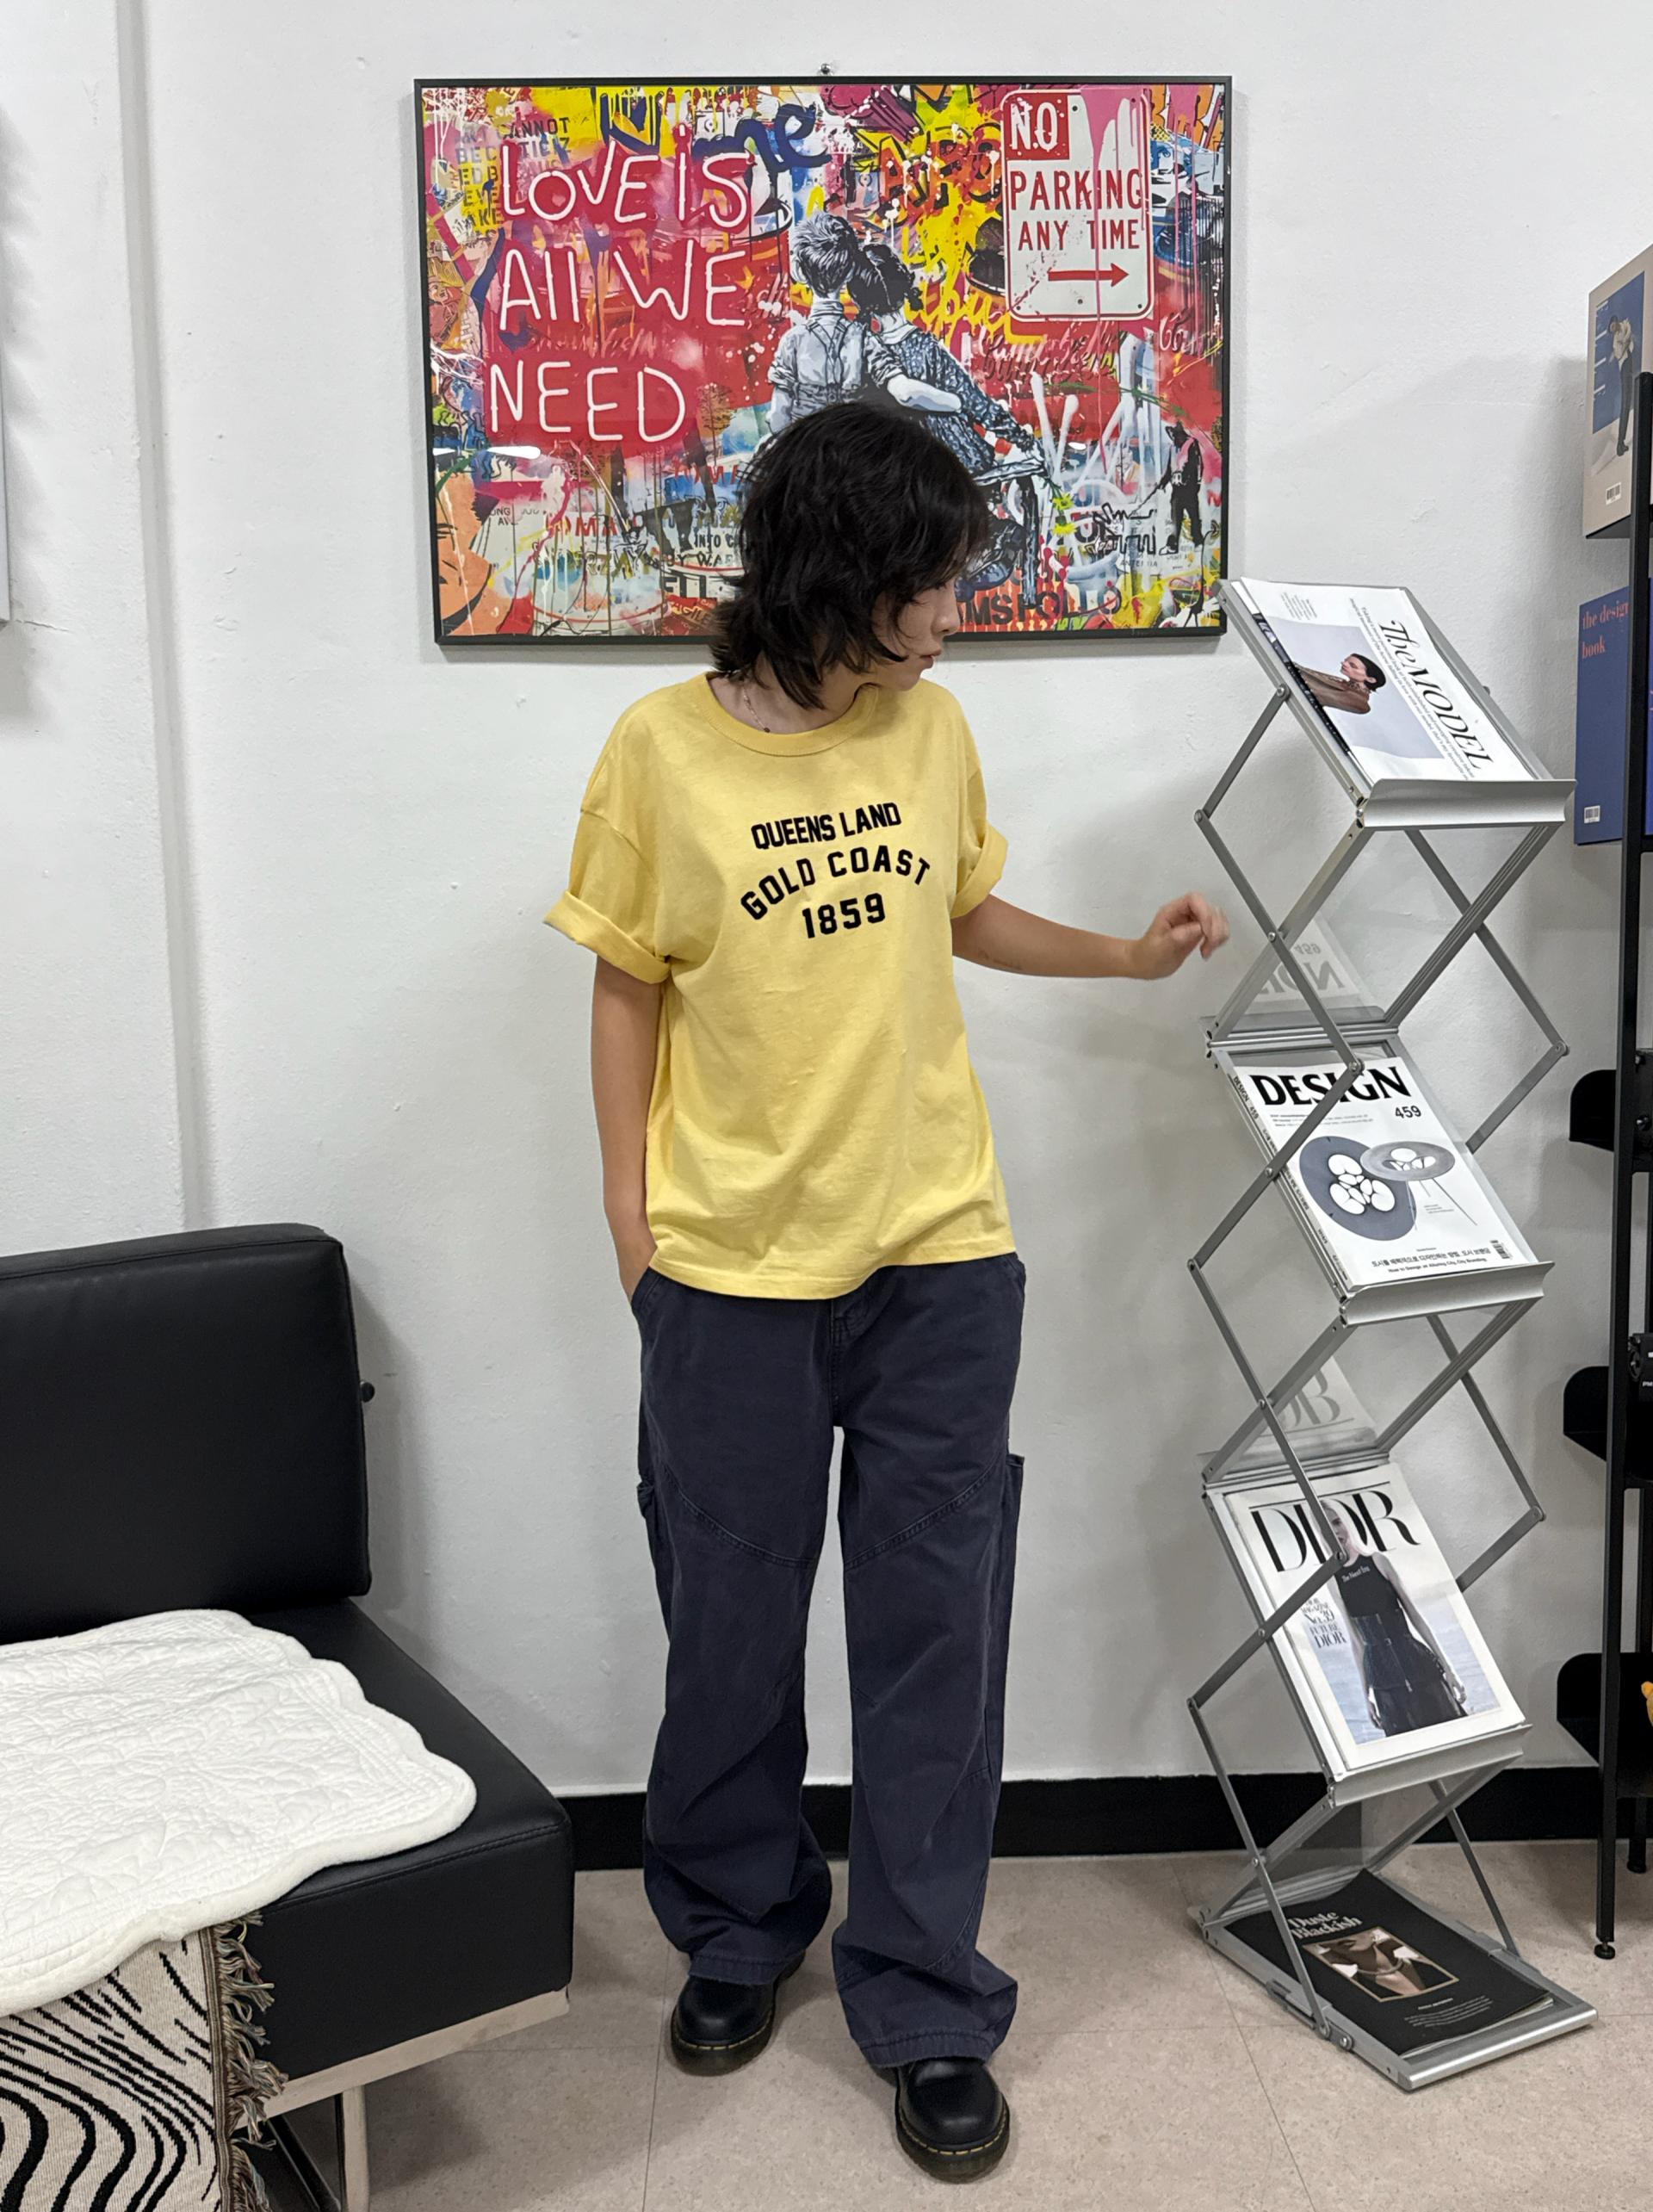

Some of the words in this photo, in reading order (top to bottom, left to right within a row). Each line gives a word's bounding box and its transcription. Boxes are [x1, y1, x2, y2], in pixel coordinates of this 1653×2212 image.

[1010, 102, 1058, 152] NO
[502, 140, 659, 223] LOVE
[1010, 169, 1142, 211] PARKING
[1018, 220, 1069, 251] ANY
[1089, 219, 1140, 250] TIME
[613, 239, 746, 327] WE
[490, 360, 685, 443] NEED
[1582, 610, 1597, 629] the
[1582, 635, 1606, 659] book
[1378, 620, 1420, 662] The
[1401, 661, 1494, 769] MODEL
[751, 815, 836, 850] QUEENS
[839, 802, 902, 837] LAND
[740, 858, 816, 920] GOLD
[827, 845, 931, 886] COAST
[802, 893, 885, 939] 1859
[1395, 1105, 1421, 1119] 459
[1314, 1632, 1347, 1648] DIOR
